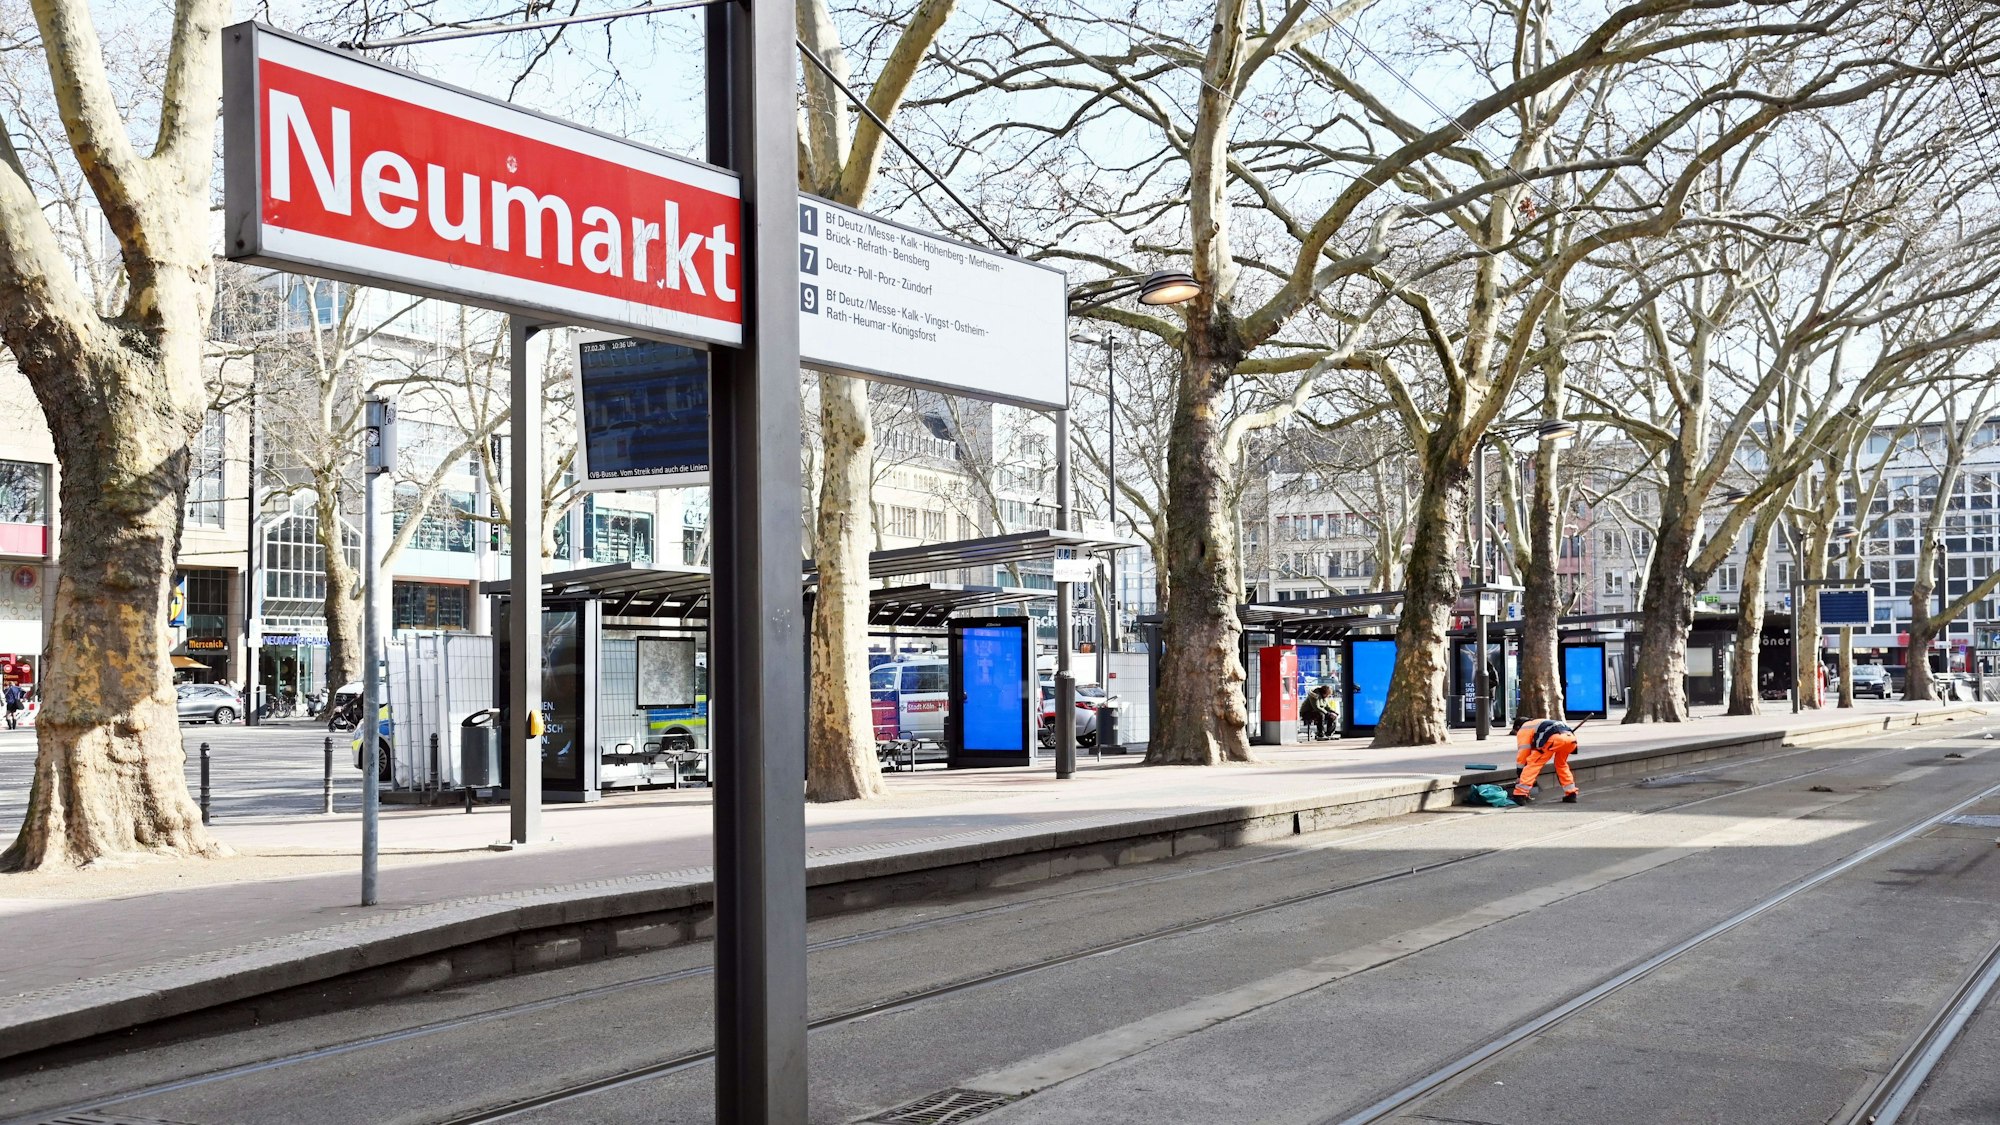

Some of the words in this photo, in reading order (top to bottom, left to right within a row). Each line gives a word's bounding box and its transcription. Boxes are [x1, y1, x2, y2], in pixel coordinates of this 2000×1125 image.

[269, 88, 736, 302] Neumarkt
[804, 210, 812, 230] 1
[826, 212, 836, 225] Bf
[804, 248, 814, 270] 7
[804, 287, 814, 309] 9
[827, 289, 836, 302] Bf
[584, 344, 606, 352] 27.02.26
[652, 466, 664, 474] sind
[665, 465, 678, 473] auch
[189, 640, 224, 649] Merzenich
[1760, 635, 1790, 646] öner
